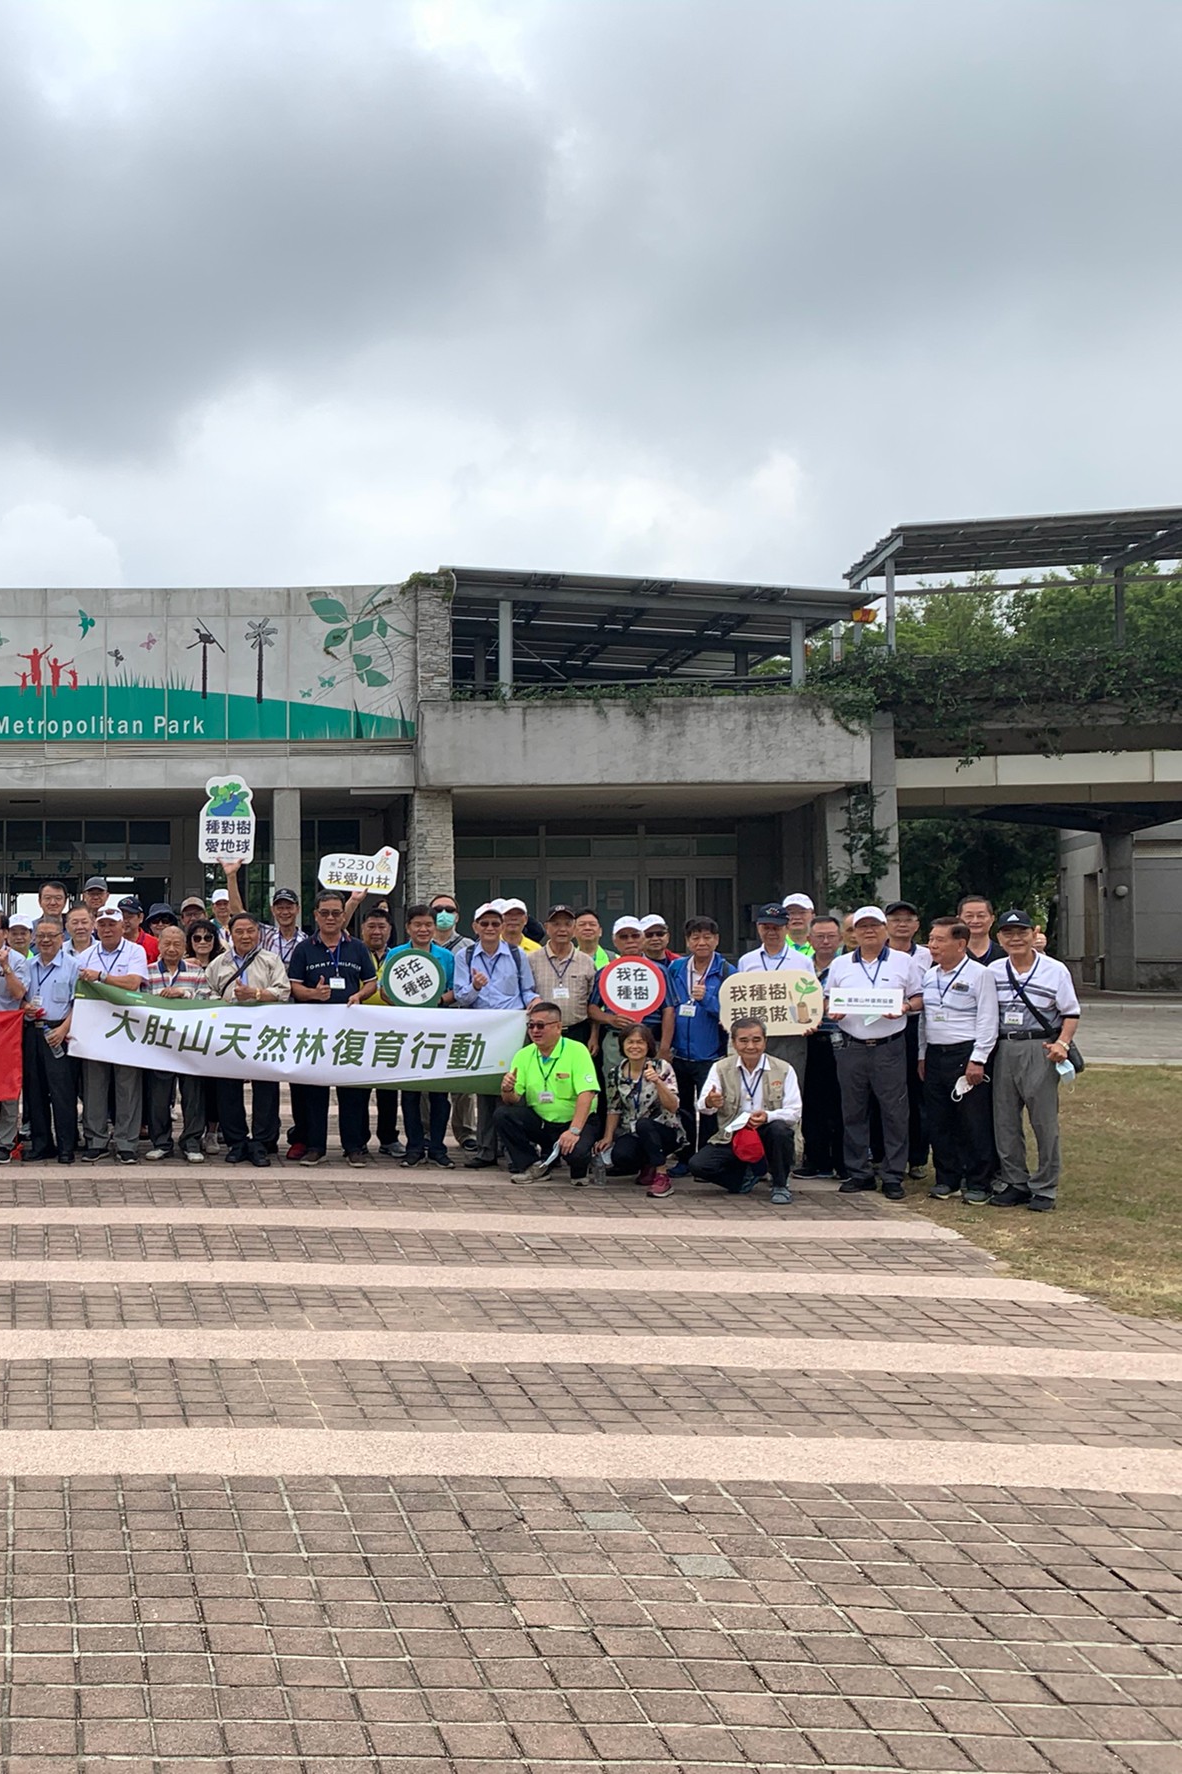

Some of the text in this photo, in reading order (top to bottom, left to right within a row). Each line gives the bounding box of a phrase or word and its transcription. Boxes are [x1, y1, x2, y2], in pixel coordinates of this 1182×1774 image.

[153, 715, 205, 735] Park
[205, 820, 251, 835] 種對樹
[205, 838, 251, 853] 愛地球
[338, 858, 375, 871] 5230
[328, 871, 390, 888] 我愛山林
[393, 957, 424, 980] 我在
[616, 967, 648, 982] 我在
[402, 973, 433, 997] 種樹
[617, 985, 649, 1000] 種樹
[730, 983, 787, 1002] 我種樹
[105, 1009, 486, 1071] 大肚山天然林復育行動
